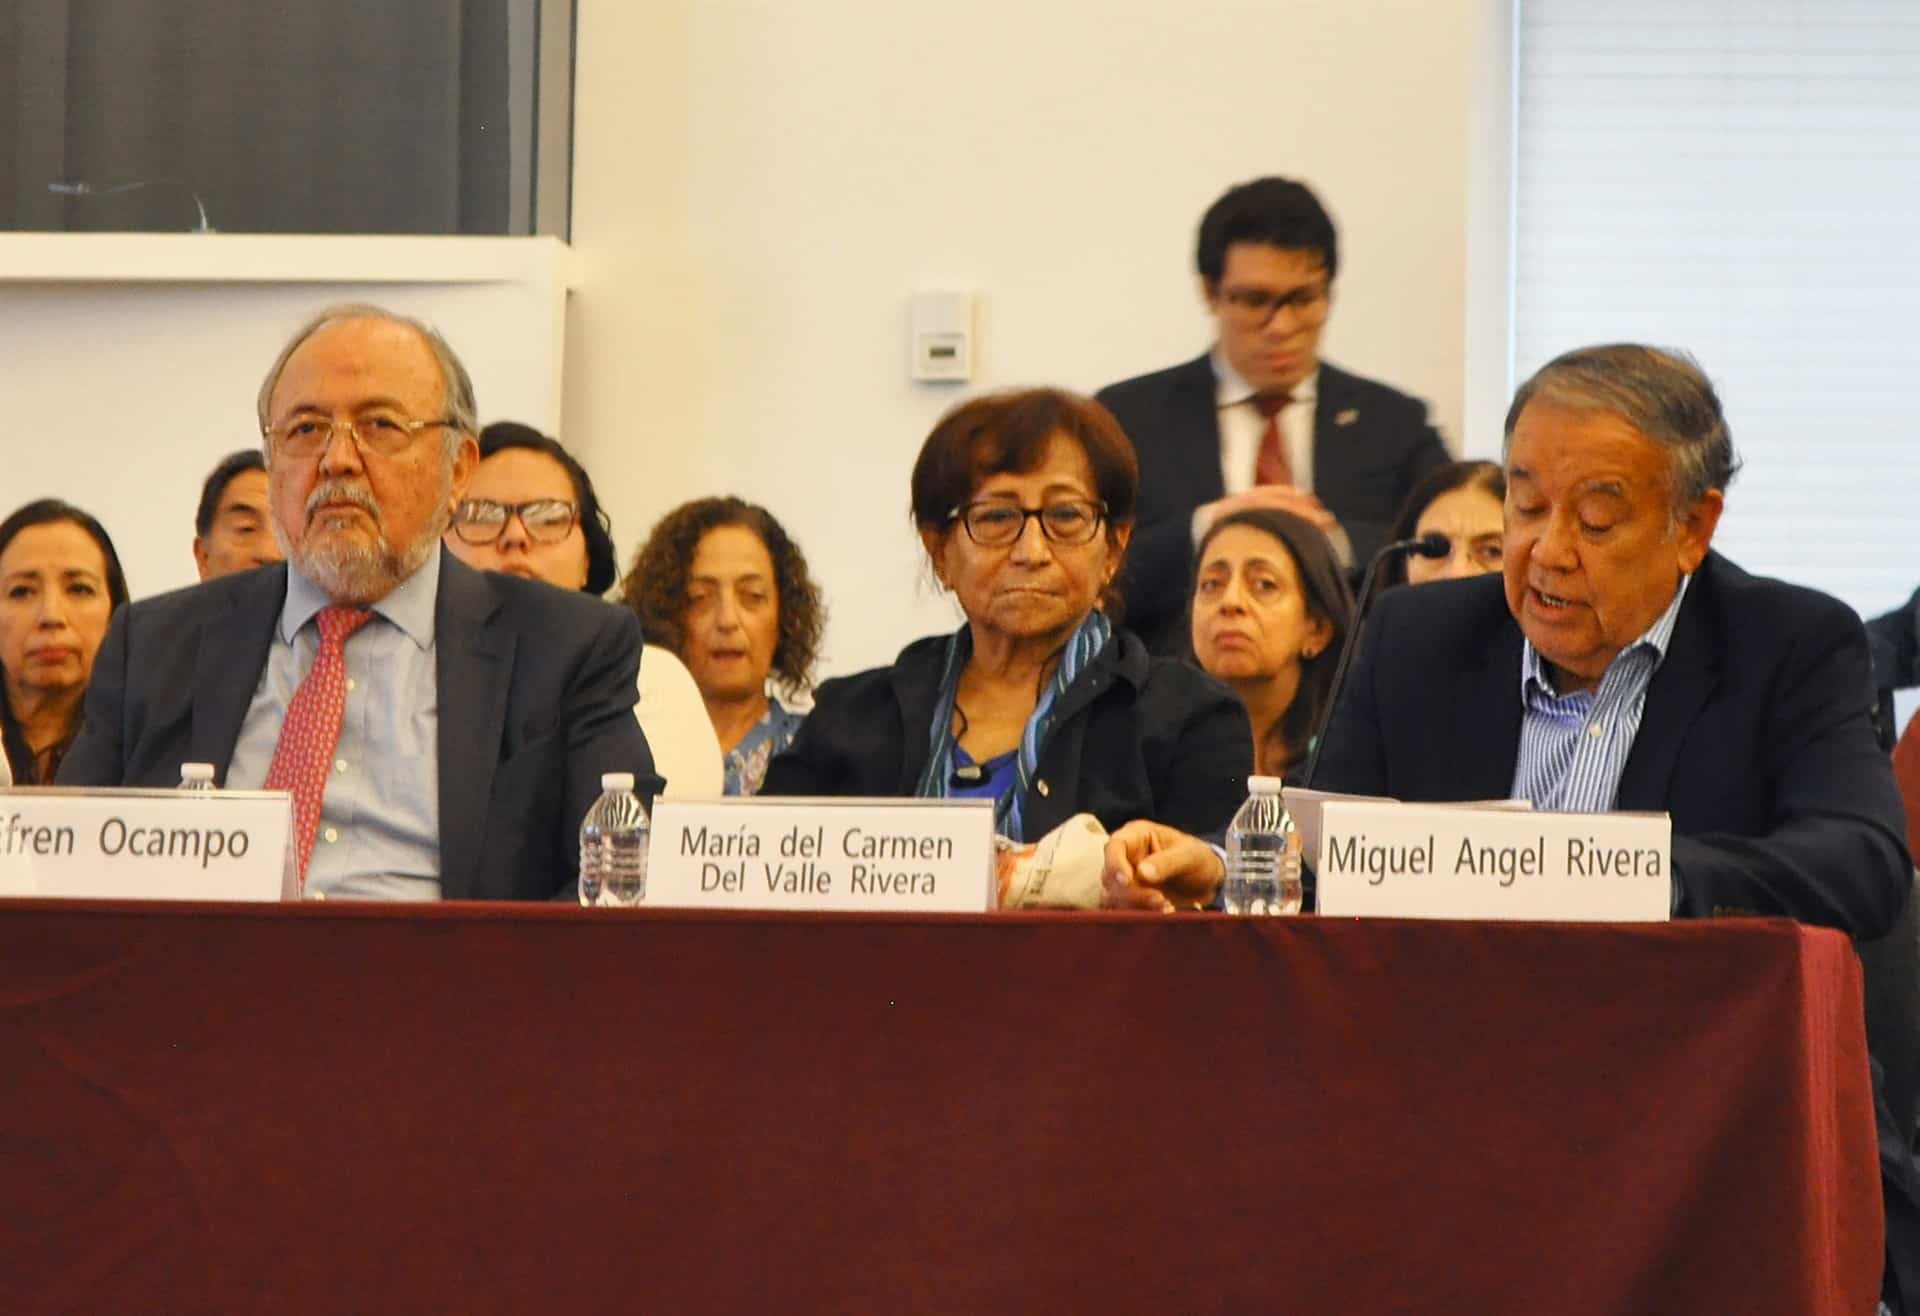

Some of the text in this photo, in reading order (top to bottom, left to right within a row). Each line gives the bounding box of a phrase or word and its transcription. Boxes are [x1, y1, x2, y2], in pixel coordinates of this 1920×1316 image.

[0, 813, 249, 868] fren Ocampo
[681, 824, 953, 859] María del Carmen
[1327, 835, 1661, 887] Miguel Angel Rivera
[701, 862, 936, 895] Del Valle Rivera
